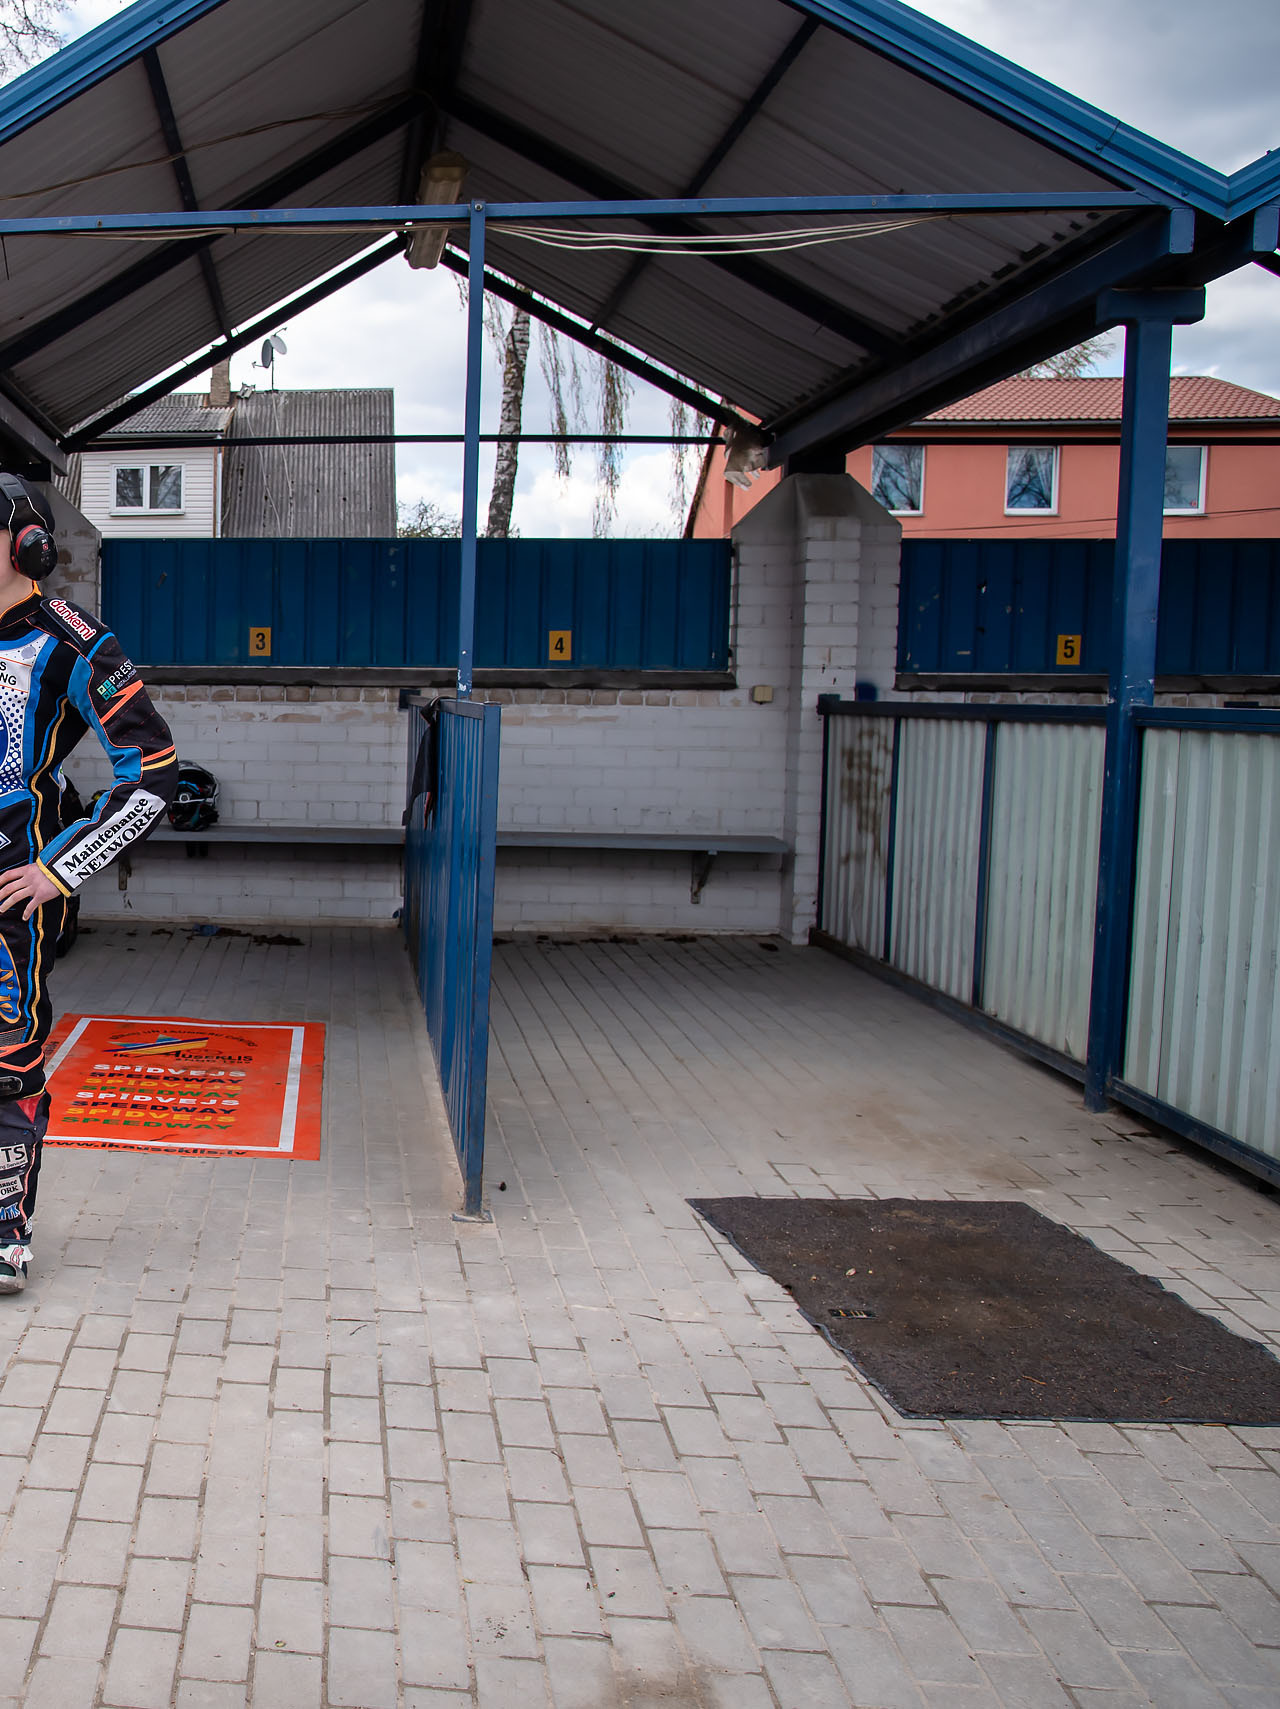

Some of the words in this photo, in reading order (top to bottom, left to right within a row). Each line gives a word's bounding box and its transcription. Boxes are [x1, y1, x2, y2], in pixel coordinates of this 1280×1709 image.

[49, 599, 97, 642] dankemi
[255, 632, 265, 651] 3
[554, 637, 565, 654] 4
[1063, 639, 1075, 659] 5
[62, 797, 149, 874] Maintenance
[75, 805, 159, 881] NETWORK
[89, 1071, 244, 1084] SPEEDWAY
[81, 1085, 240, 1098] SPEEDWAY
[71, 1100, 238, 1114] SPEEDWAY
[61, 1116, 233, 1130] SPEEDWAY
